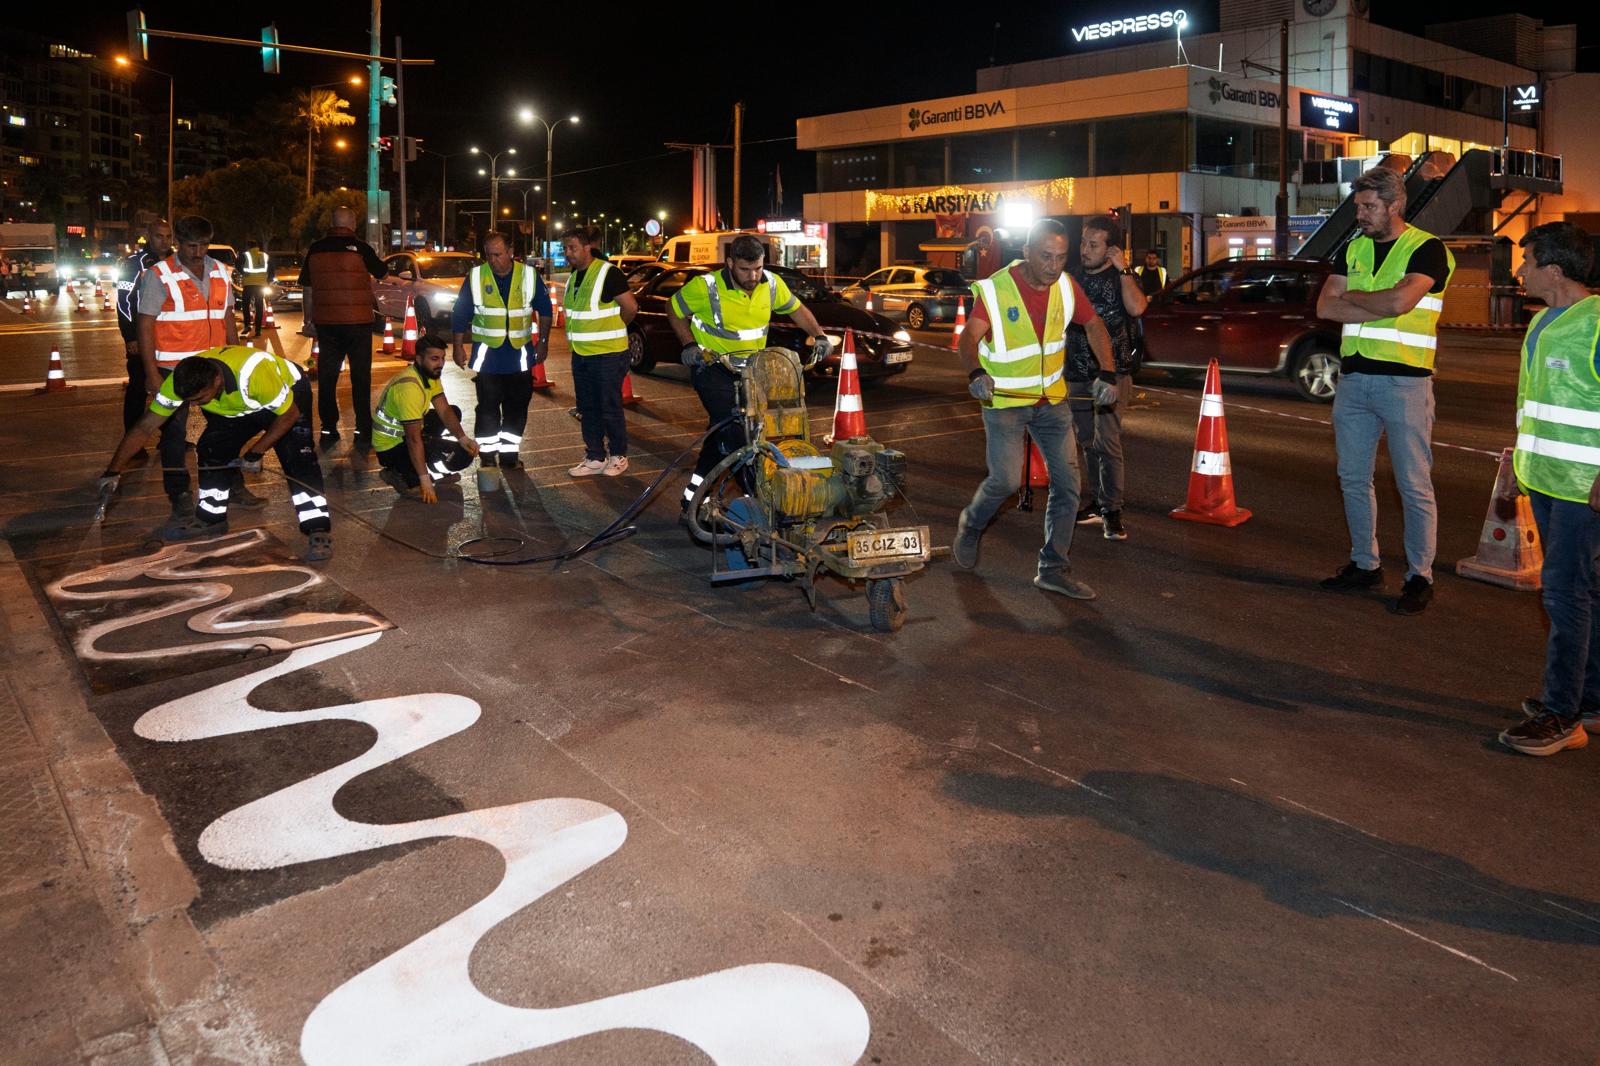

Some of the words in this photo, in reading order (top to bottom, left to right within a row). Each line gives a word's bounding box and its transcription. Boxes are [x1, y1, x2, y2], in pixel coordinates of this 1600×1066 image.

[1071, 9, 1187, 42] VIESPRESSO
[1221, 82, 1257, 105] Garanti
[921, 107, 962, 125] Garanti
[964, 100, 1006, 120] BBVA
[914, 192, 1004, 215] KARŞIYAKA
[1246, 220, 1268, 228] BBVA
[856, 540, 869, 553] 35
[872, 538, 896, 551] CIZ
[904, 537, 917, 549] 03
